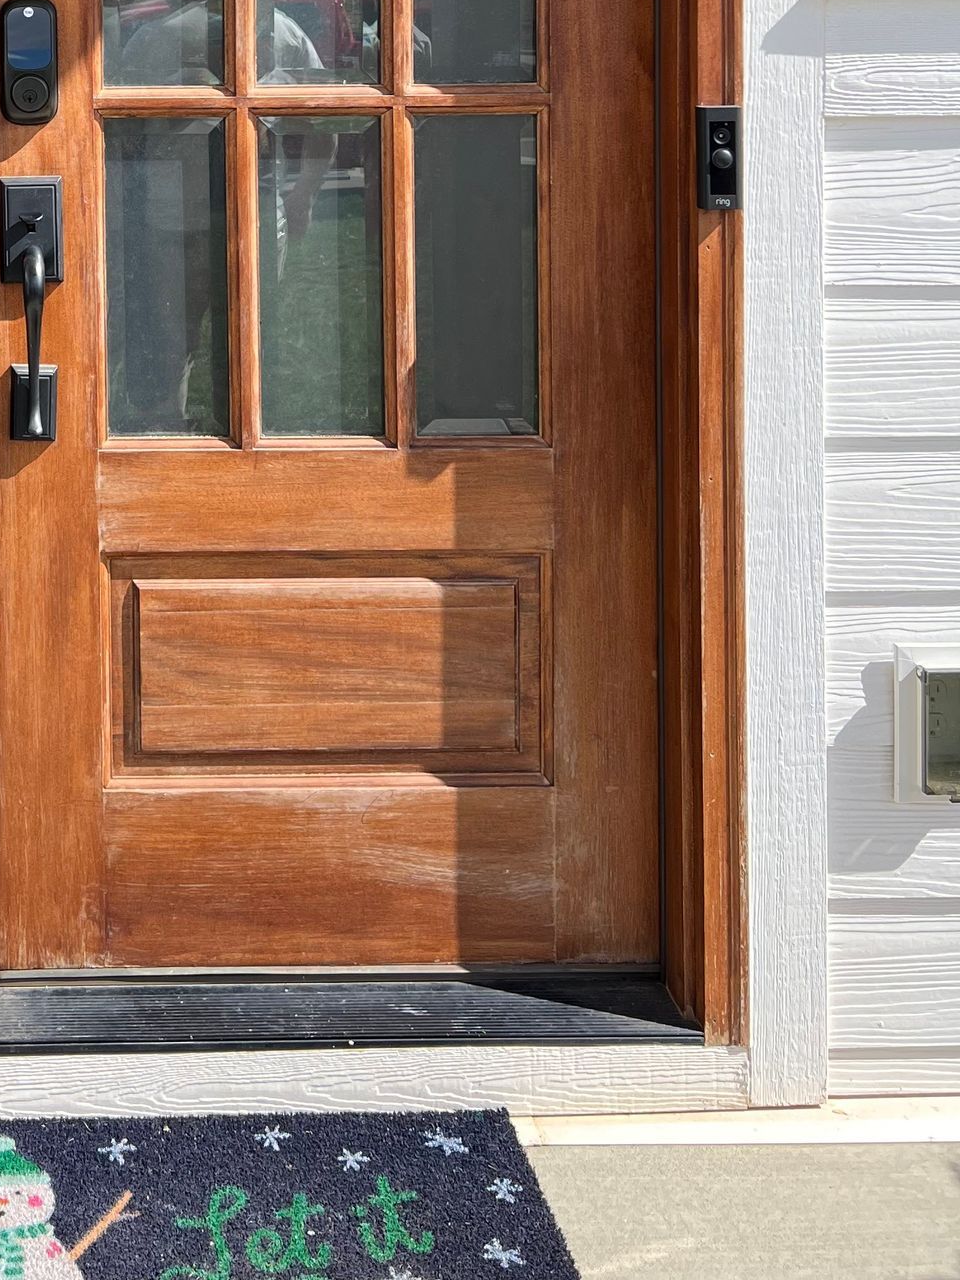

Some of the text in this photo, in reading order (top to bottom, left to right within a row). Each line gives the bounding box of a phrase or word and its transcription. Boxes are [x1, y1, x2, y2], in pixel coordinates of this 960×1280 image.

[715, 197, 731, 207] ring
[159, 1174, 435, 1280] Let it
